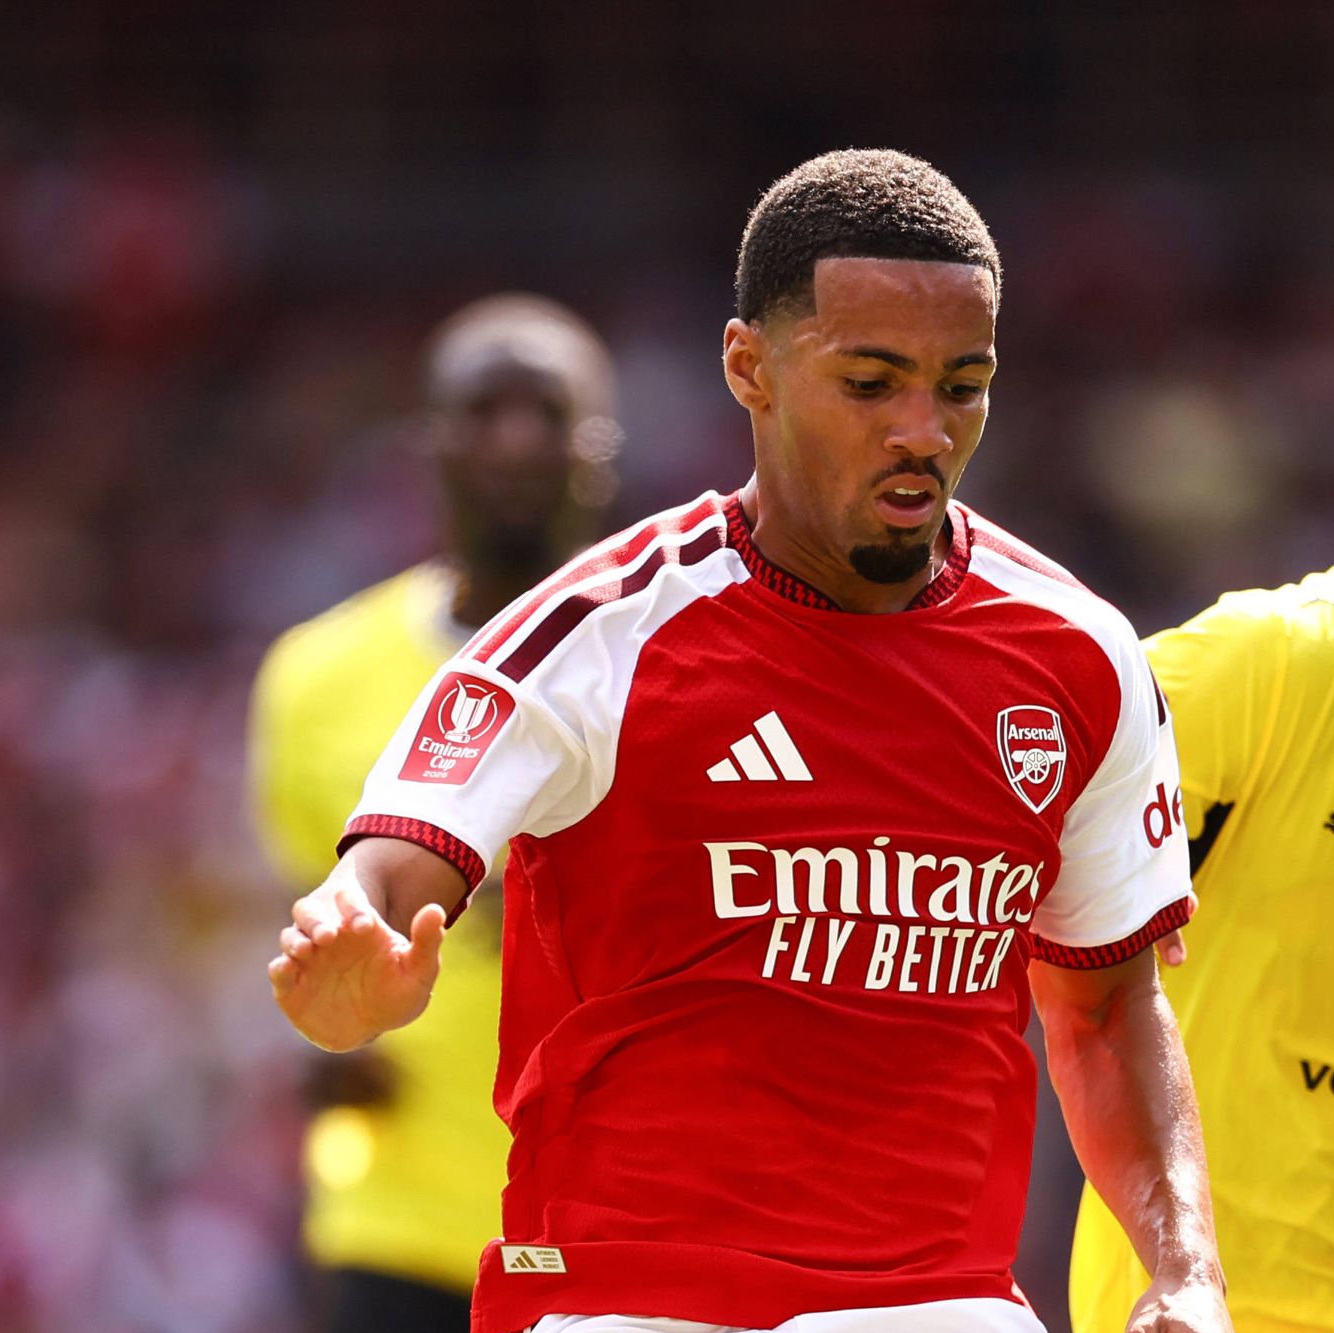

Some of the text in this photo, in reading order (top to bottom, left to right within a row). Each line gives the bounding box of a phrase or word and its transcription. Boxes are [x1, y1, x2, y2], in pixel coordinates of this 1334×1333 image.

[1007, 723, 1059, 741] Arsenal
[418, 736, 481, 759] Emirates
[429, 755, 458, 771] Cup
[702, 836, 1045, 926] Emirates
[761, 916, 1016, 994] FLY BETTER
